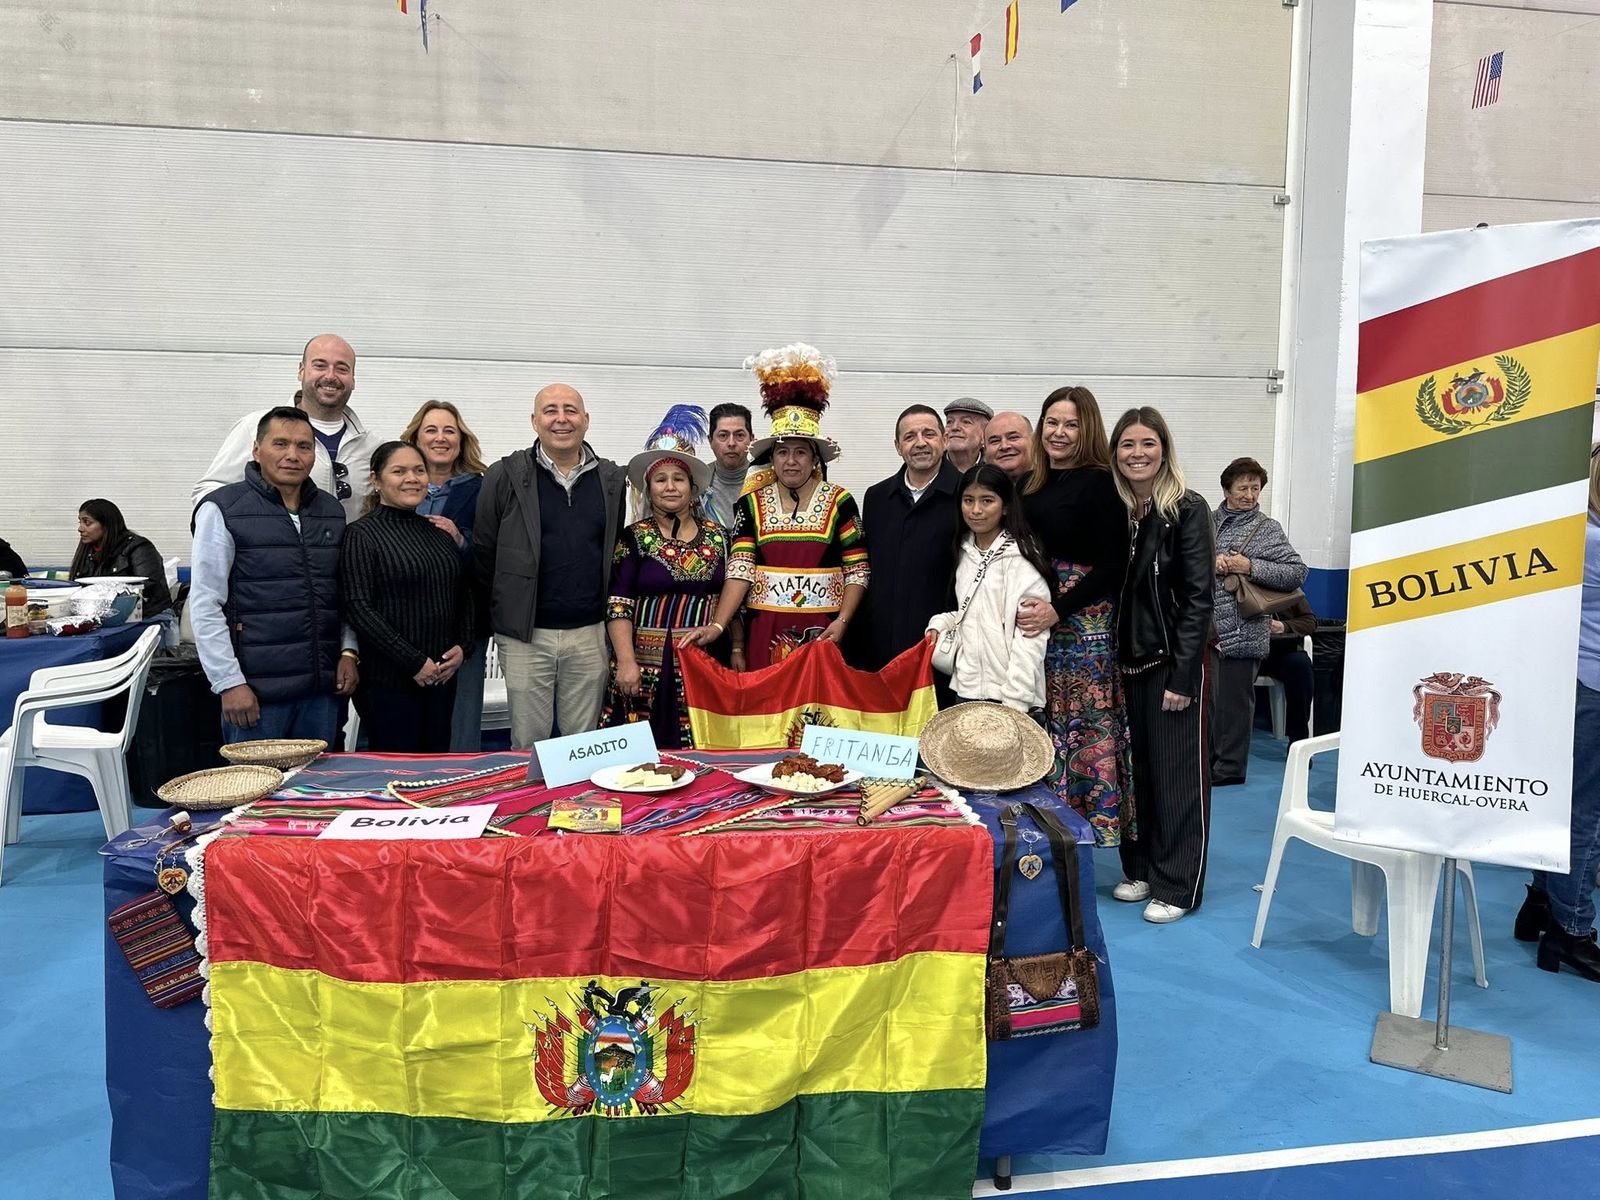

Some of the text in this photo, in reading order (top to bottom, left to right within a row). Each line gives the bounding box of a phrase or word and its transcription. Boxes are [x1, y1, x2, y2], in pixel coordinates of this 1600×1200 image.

[770, 576, 827, 599] TIATACO
[1365, 547, 1558, 609] BOLIVIA
[569, 738, 628, 761] ASADITO
[811, 736, 913, 767] FRITANGA
[1361, 762, 1549, 796] AYUNTAMIENTO
[1374, 782, 1529, 812] DE HUERCAL-OVERA
[350, 814, 471, 828] Bolivia
